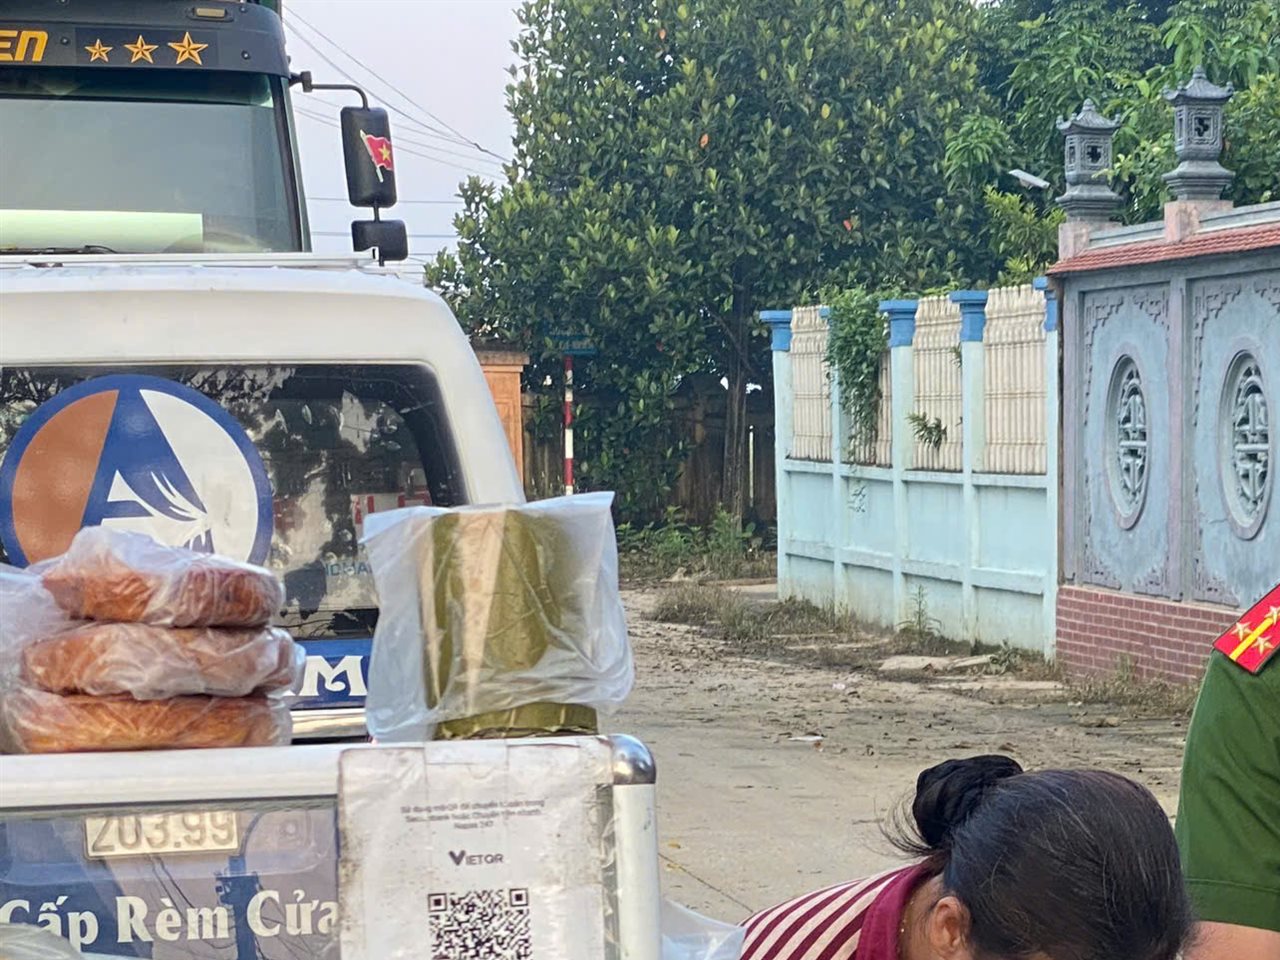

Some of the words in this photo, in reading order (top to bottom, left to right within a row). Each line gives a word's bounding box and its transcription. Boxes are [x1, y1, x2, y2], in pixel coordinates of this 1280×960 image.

[0, 895, 99, 953] Cấp
[115, 895, 231, 943] Rèm
[246, 888, 339, 938] Cửa
